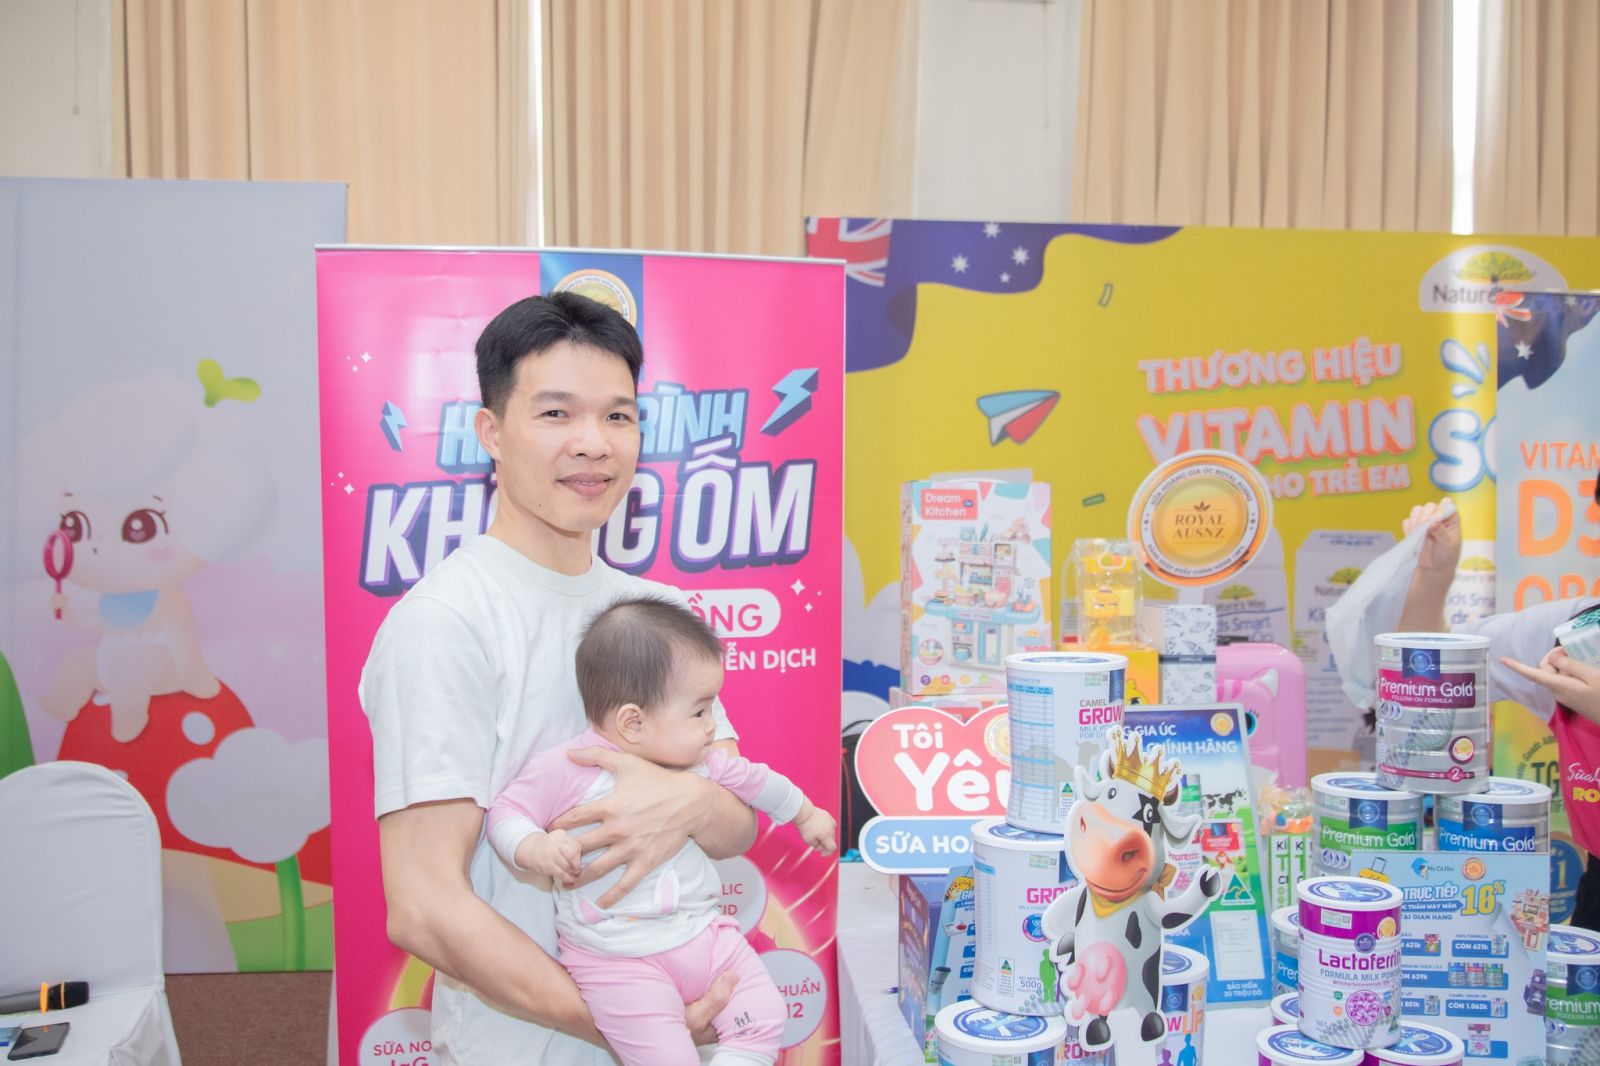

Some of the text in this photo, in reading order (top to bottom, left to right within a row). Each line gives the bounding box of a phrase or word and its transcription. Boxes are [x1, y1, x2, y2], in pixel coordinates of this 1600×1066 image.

[1138, 336, 1402, 393] THƯƠNG HIỆU
[1137, 395, 1416, 467] VITAMIN
[1309, 457, 1362, 496] TRẺ
[1366, 463, 1411, 492] EM
[678, 436, 816, 561] ỐM
[925, 493, 961, 503] Dream
[926, 507, 966, 517] Kitchen
[1175, 514, 1227, 526] ROYAL
[1173, 527, 1225, 539] AUSNZ
[763, 647, 816, 674] DỊCH
[1380, 677, 1473, 698] Premium Gold
[1080, 698, 1108, 707] CAMEL
[1078, 704, 1123, 725] GROW
[892, 722, 943, 749] Tôi
[1158, 722, 1176, 736] ÚC
[1196, 738, 1238, 754] HÃNG
[1451, 768, 1460, 781] 2
[1573, 787, 1600, 803] RO
[875, 830, 974, 854] SỮA HO
[1322, 825, 1415, 848] Premium Gold
[1439, 827, 1535, 851] Premium Gold
[1403, 886, 1433, 903] TRỰC
[1435, 882, 1458, 899] TIẾP
[1320, 969, 1358, 981] FORMULA
[1361, 973, 1379, 981] MILK
[1020, 980, 1042, 990] 500g
[373, 1041, 405, 1056] SỮA
